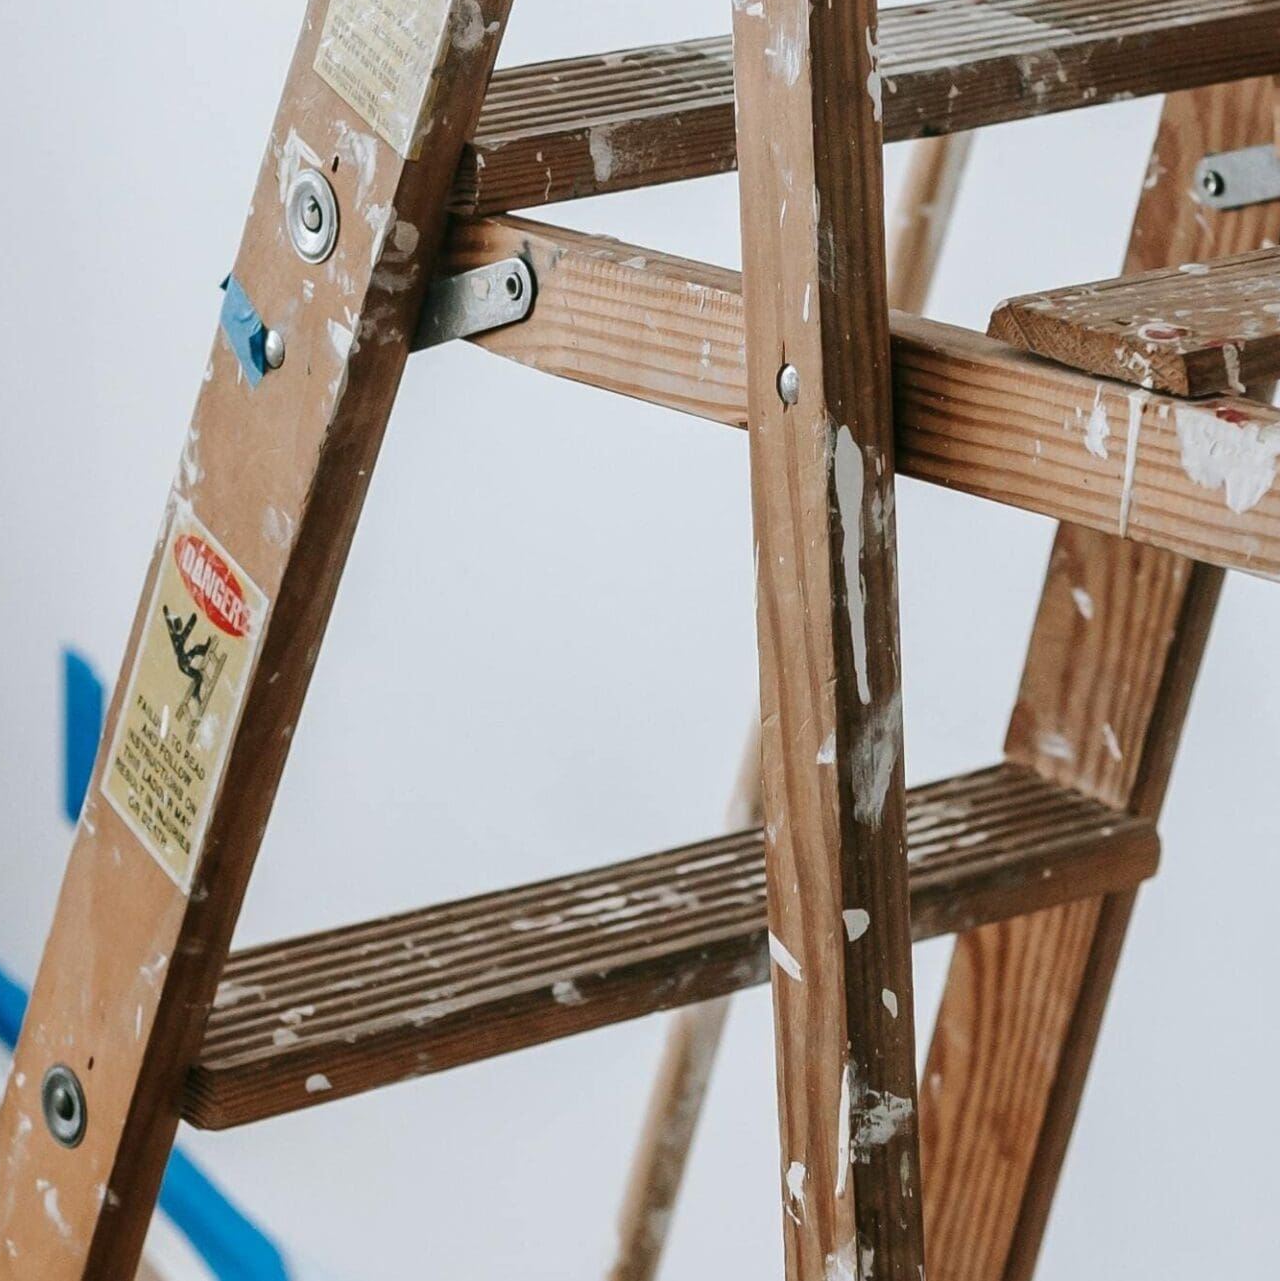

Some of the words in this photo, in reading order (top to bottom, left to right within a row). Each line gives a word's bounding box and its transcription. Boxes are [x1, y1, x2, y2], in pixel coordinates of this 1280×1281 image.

[182, 542, 243, 629] DANGER
[136, 695, 170, 739] FAILU
[172, 733, 182, 754] TO
[183, 749, 206, 781] READ
[141, 723, 158, 748] AND
[159, 743, 192, 786] FOLLOW
[141, 810, 168, 846] DEATH
[174, 806, 192, 831] MAY
[185, 796, 196, 816] ON
